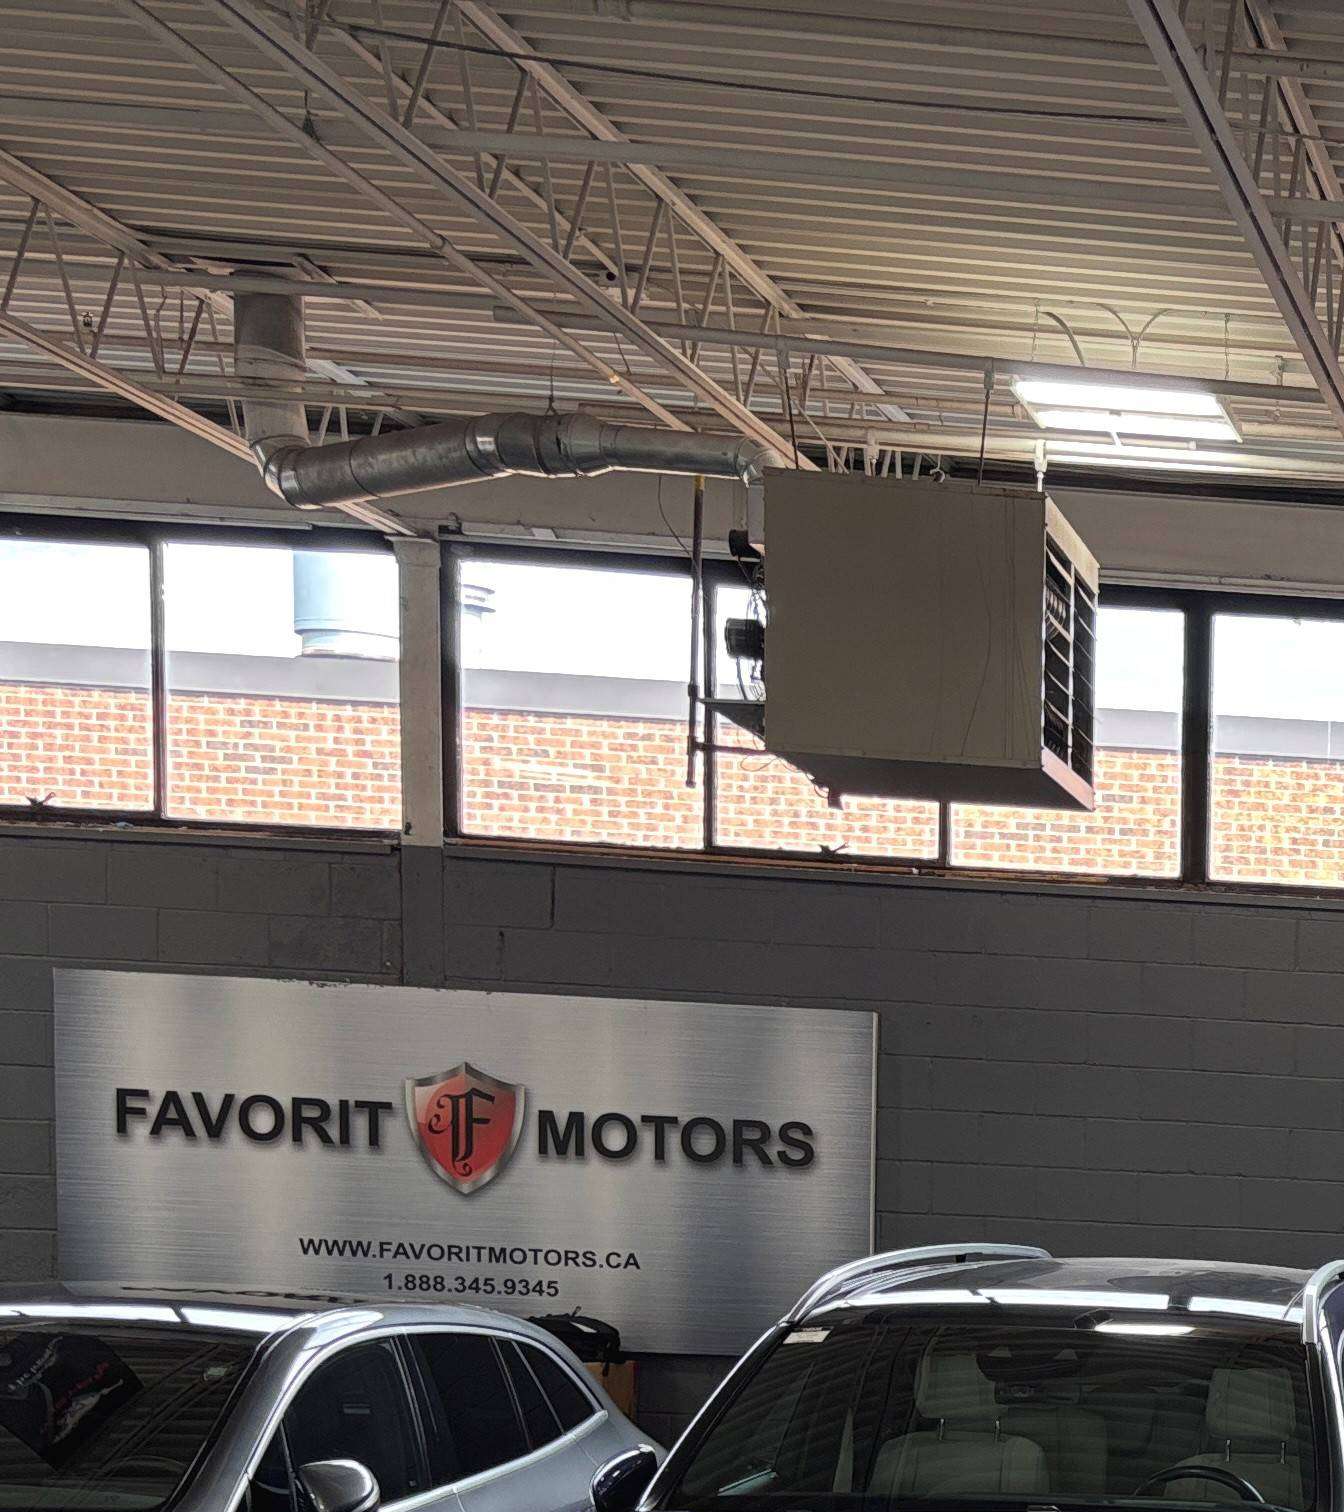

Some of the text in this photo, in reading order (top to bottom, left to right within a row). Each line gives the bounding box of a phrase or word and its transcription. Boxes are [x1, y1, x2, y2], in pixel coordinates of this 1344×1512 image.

[116, 1087, 394, 1149] FAVORIT
[538, 1110, 815, 1170] MOTORS
[298, 1237, 642, 1270] WWW.FAVORITMOTORS.CA
[382, 1272, 560, 1298] 1.888.345.9345
